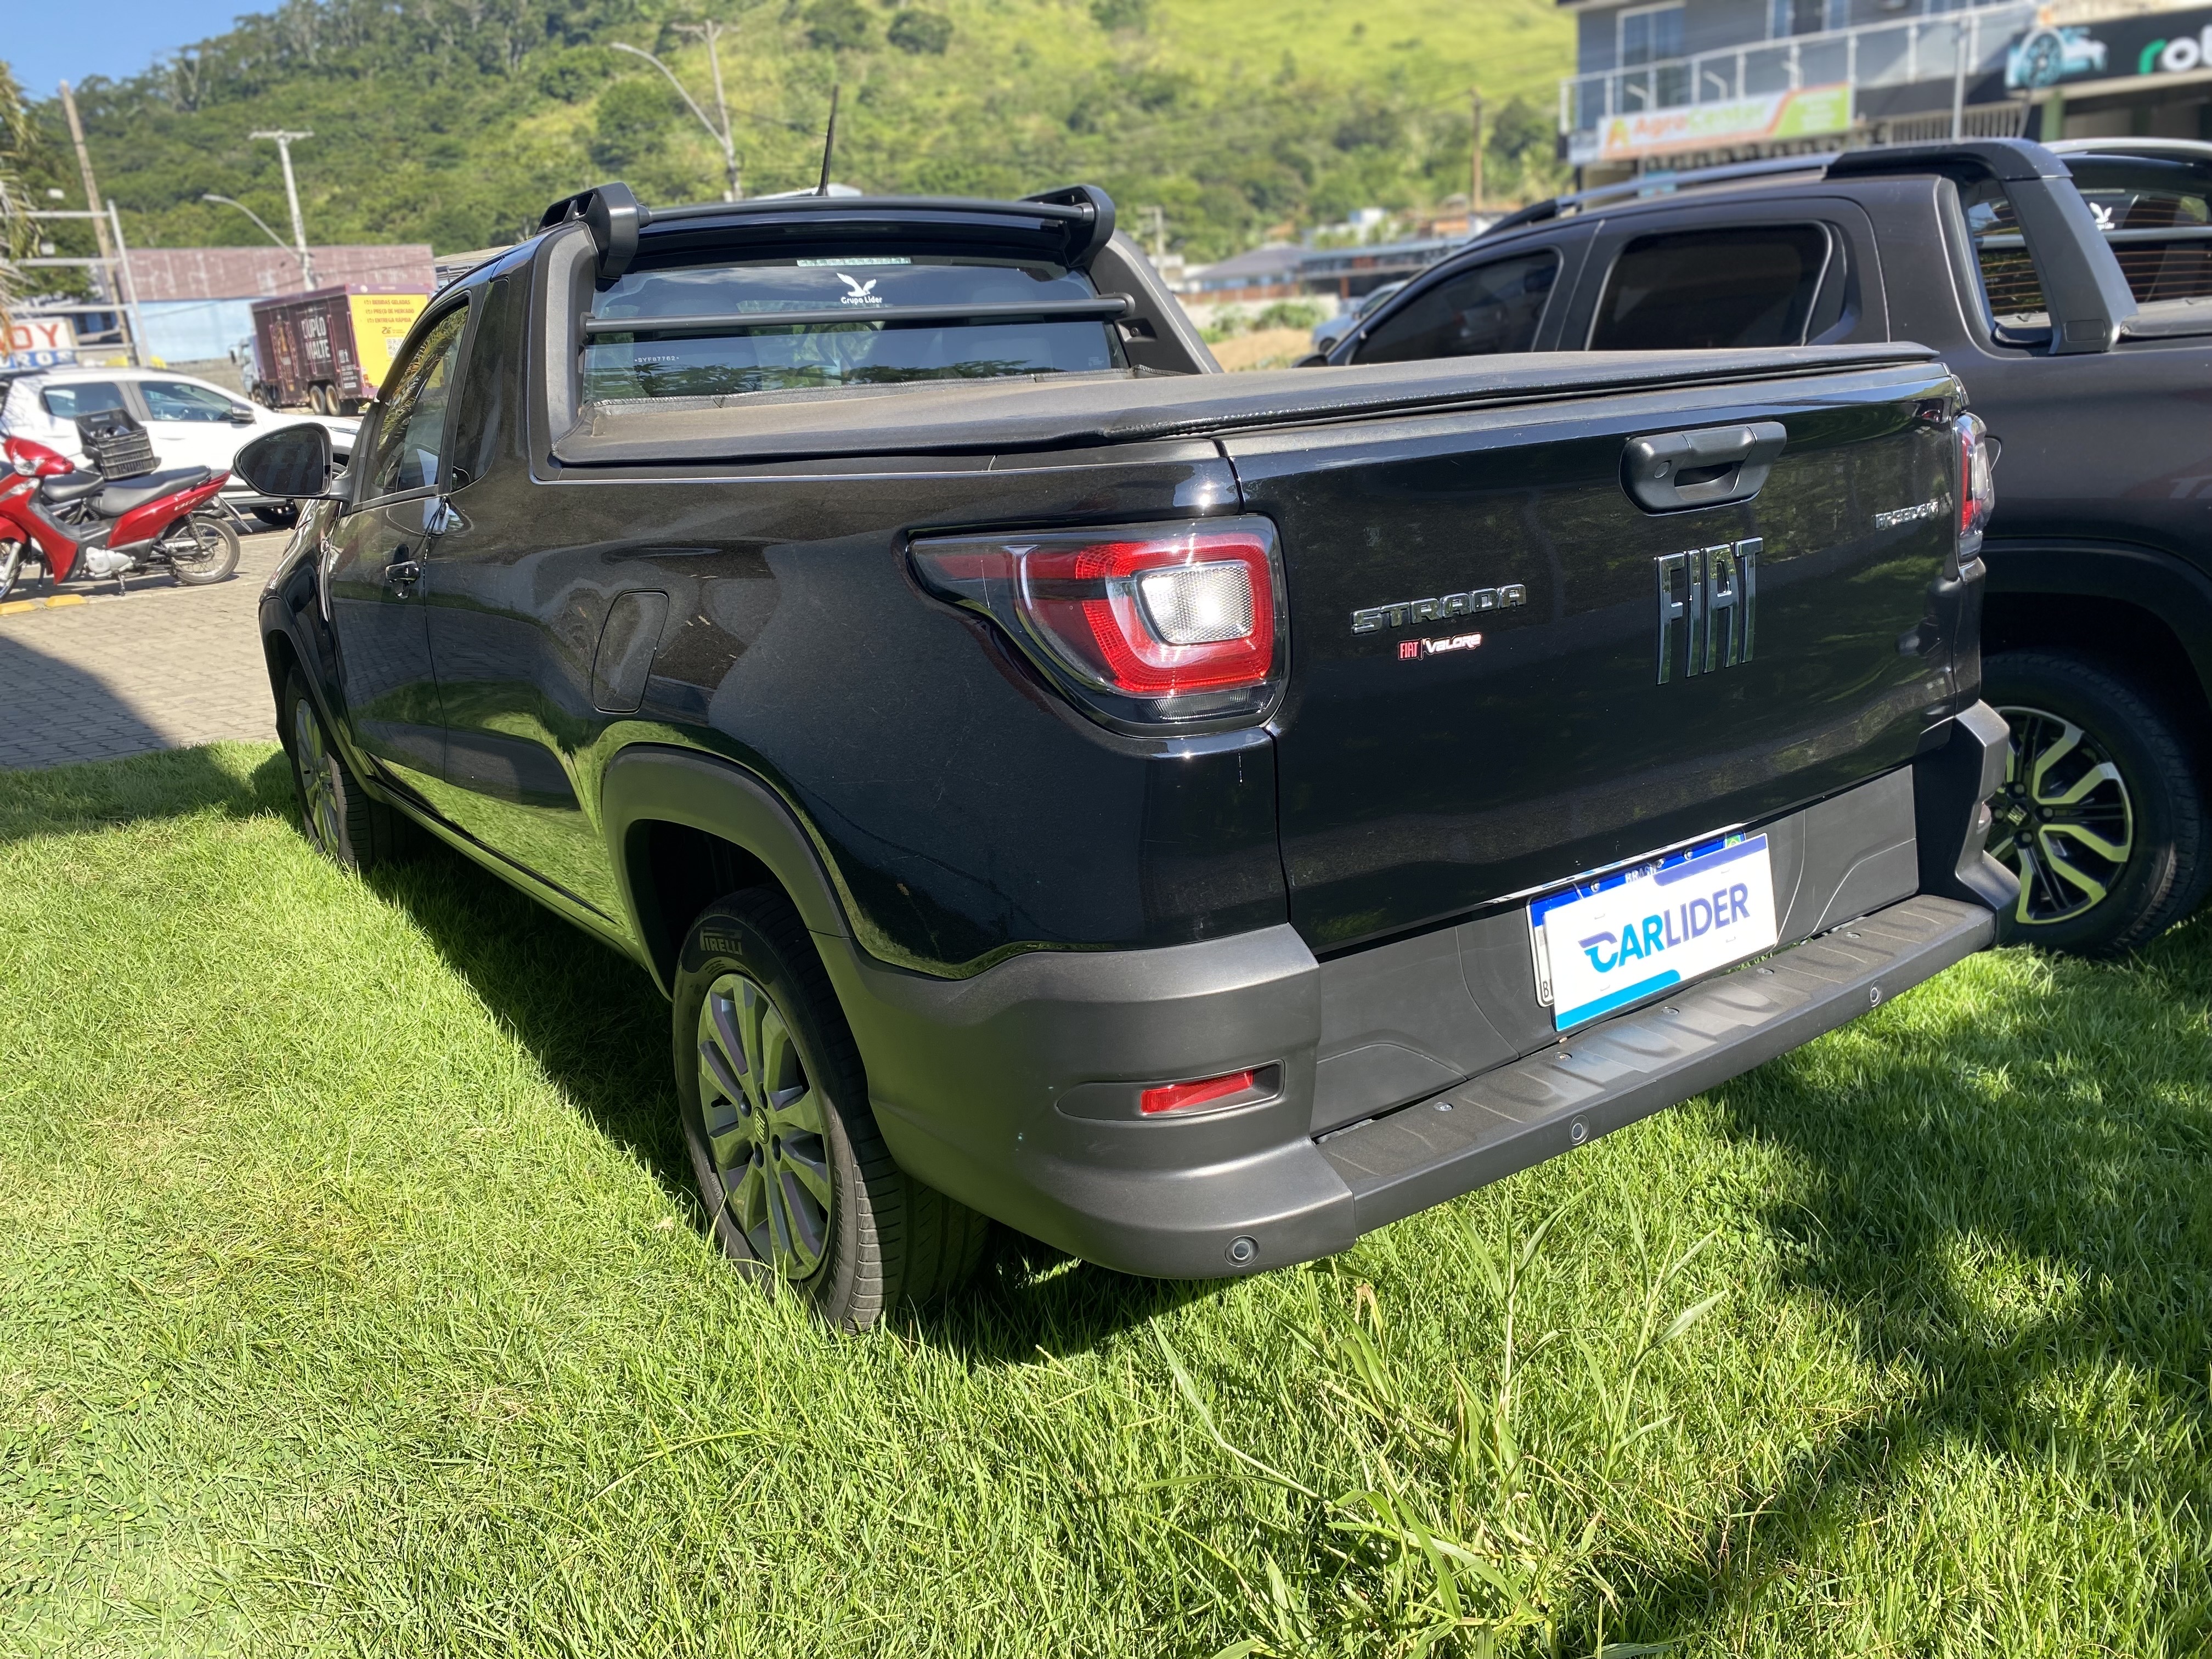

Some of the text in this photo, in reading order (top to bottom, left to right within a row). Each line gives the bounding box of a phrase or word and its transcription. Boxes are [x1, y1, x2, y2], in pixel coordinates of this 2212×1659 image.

[841, 297, 864, 305] Grupo
[305, 338, 330, 360] MALTE
[1351, 583, 1527, 635] STRADA
[1656, 537, 1764, 686] FIAT
[1400, 641, 1419, 659] FIAT
[699, 926, 743, 956] PIRELLI
[1578, 883, 1751, 973] CARLIDER
[755, 1110, 765, 1141] FIAT
